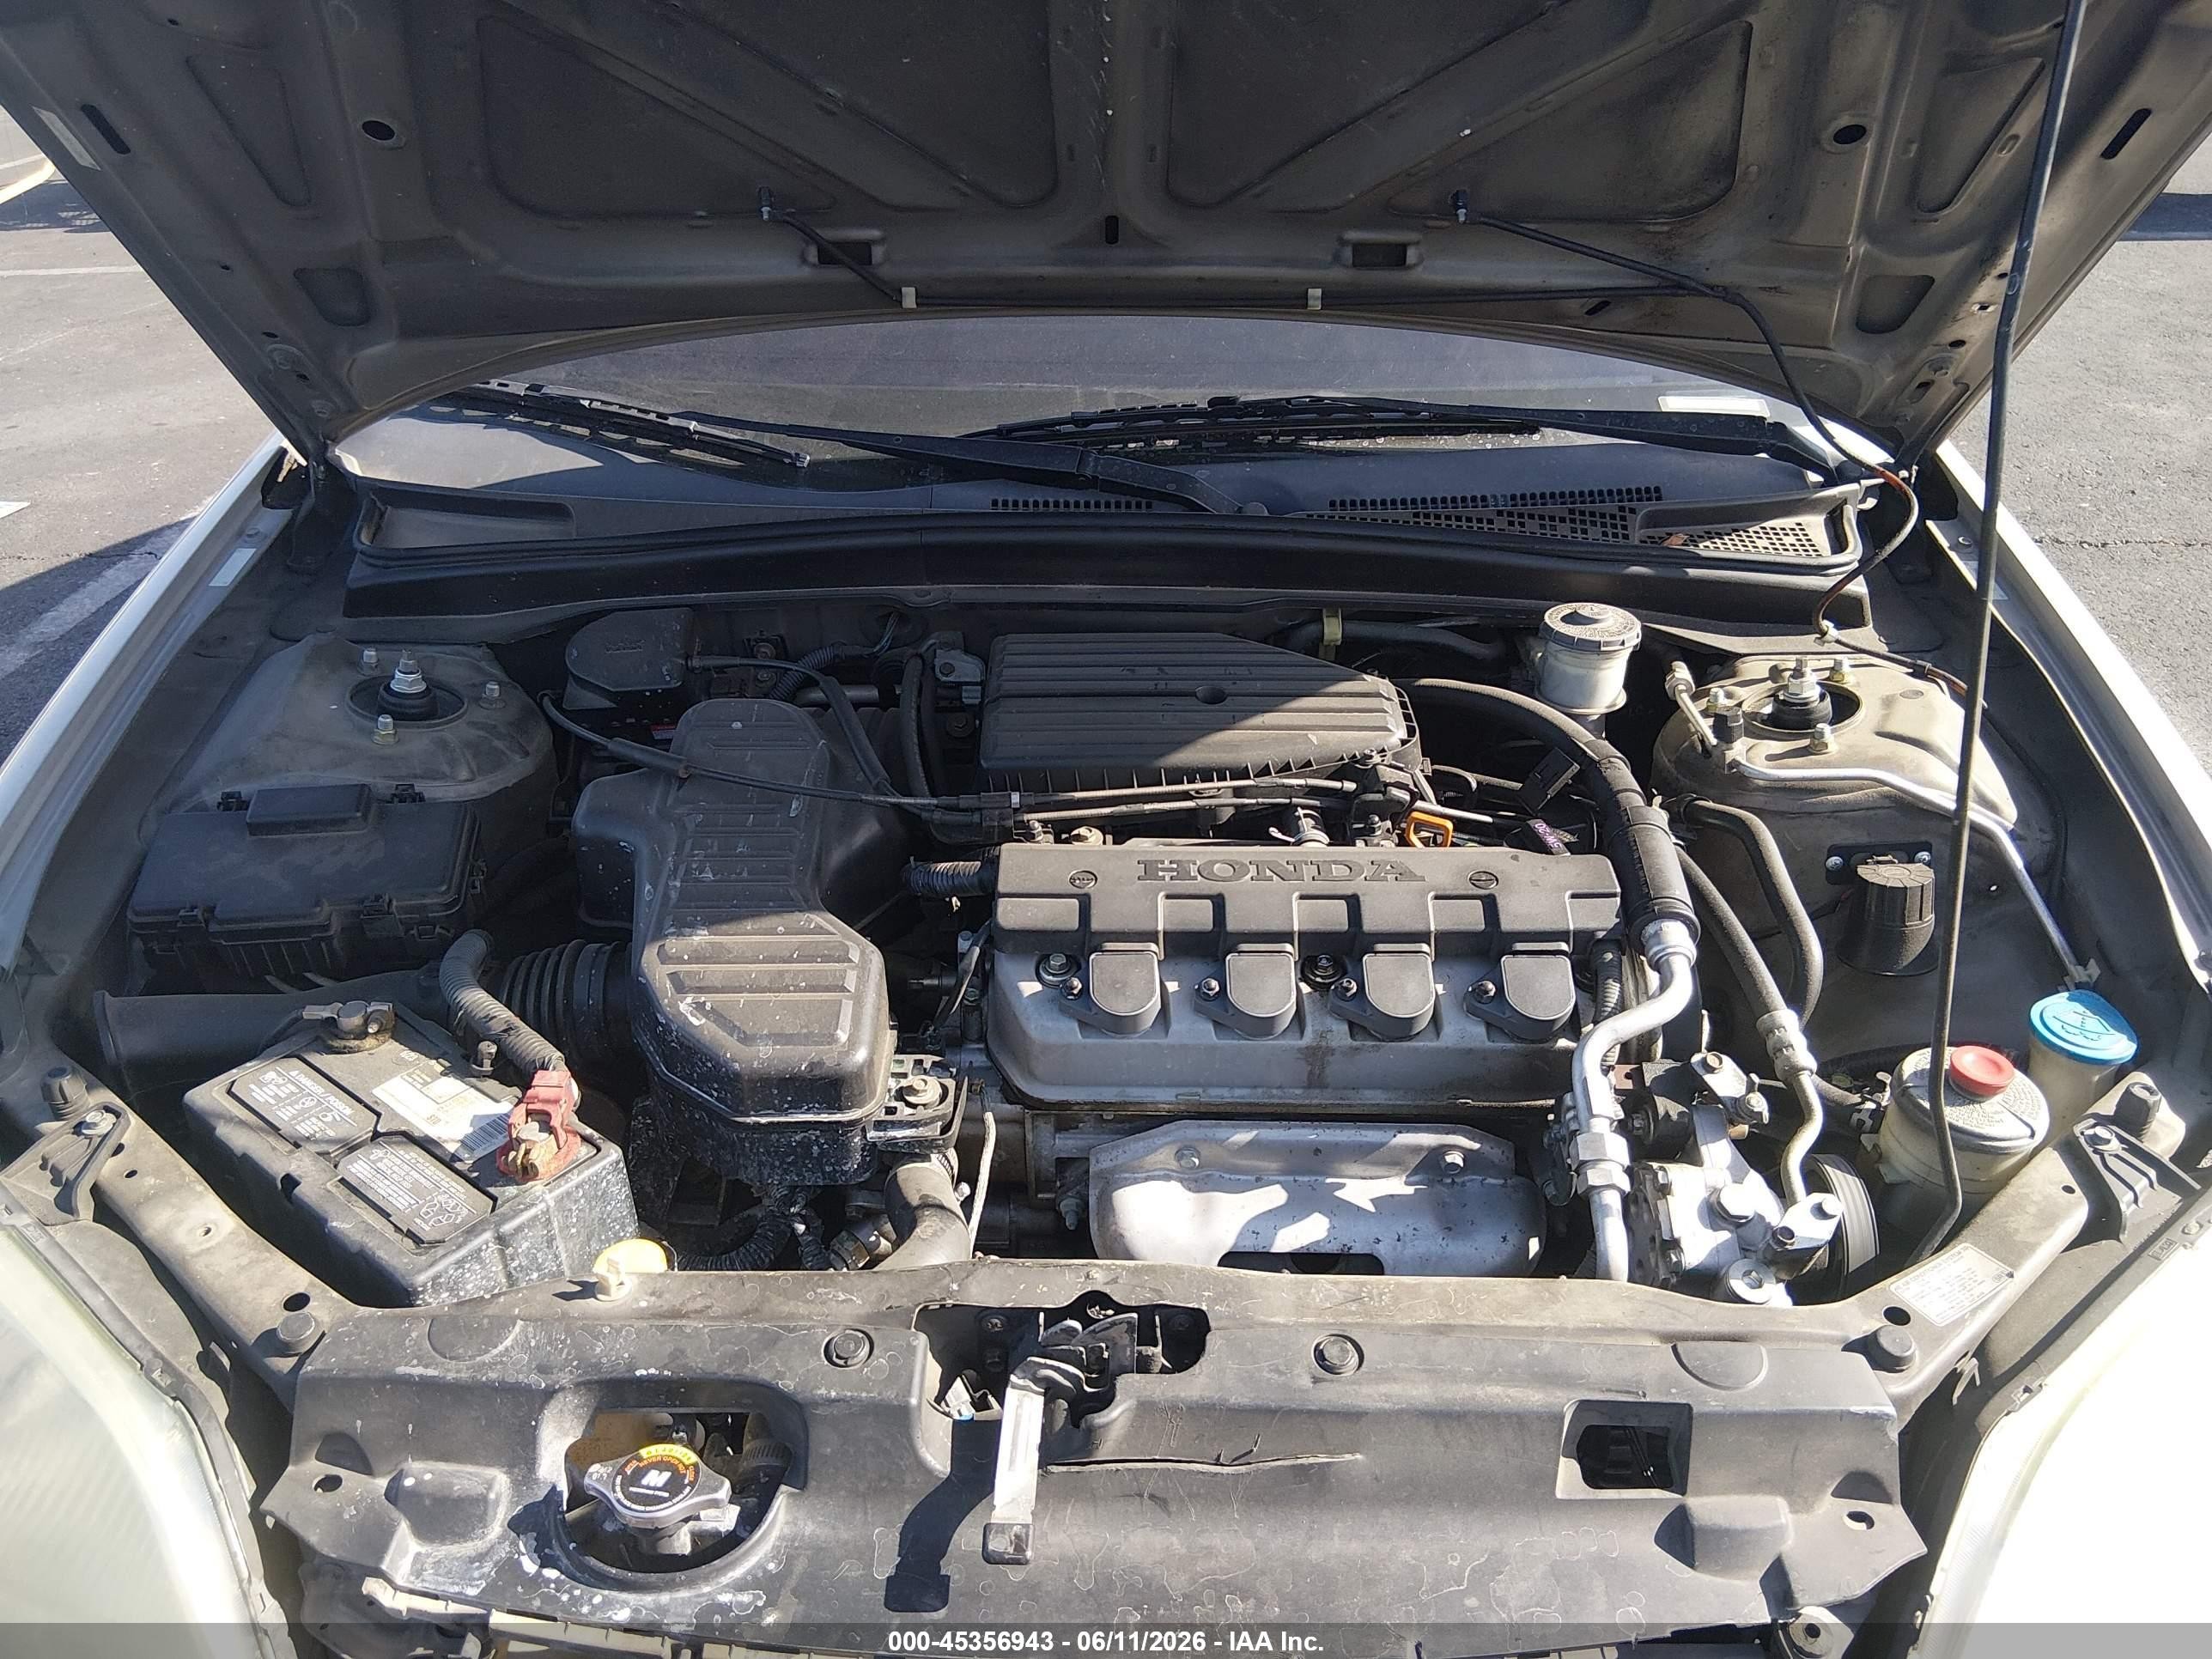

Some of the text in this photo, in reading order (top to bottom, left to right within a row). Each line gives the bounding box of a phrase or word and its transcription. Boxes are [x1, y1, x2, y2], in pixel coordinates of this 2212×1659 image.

[1137, 859, 1425, 883] HONDA
[295, 1073, 325, 1097] DANGER
[638, 1456, 661, 1468] NEVER
[662, 1455, 679, 1467] OPEN
[641, 1469, 672, 1487] M
